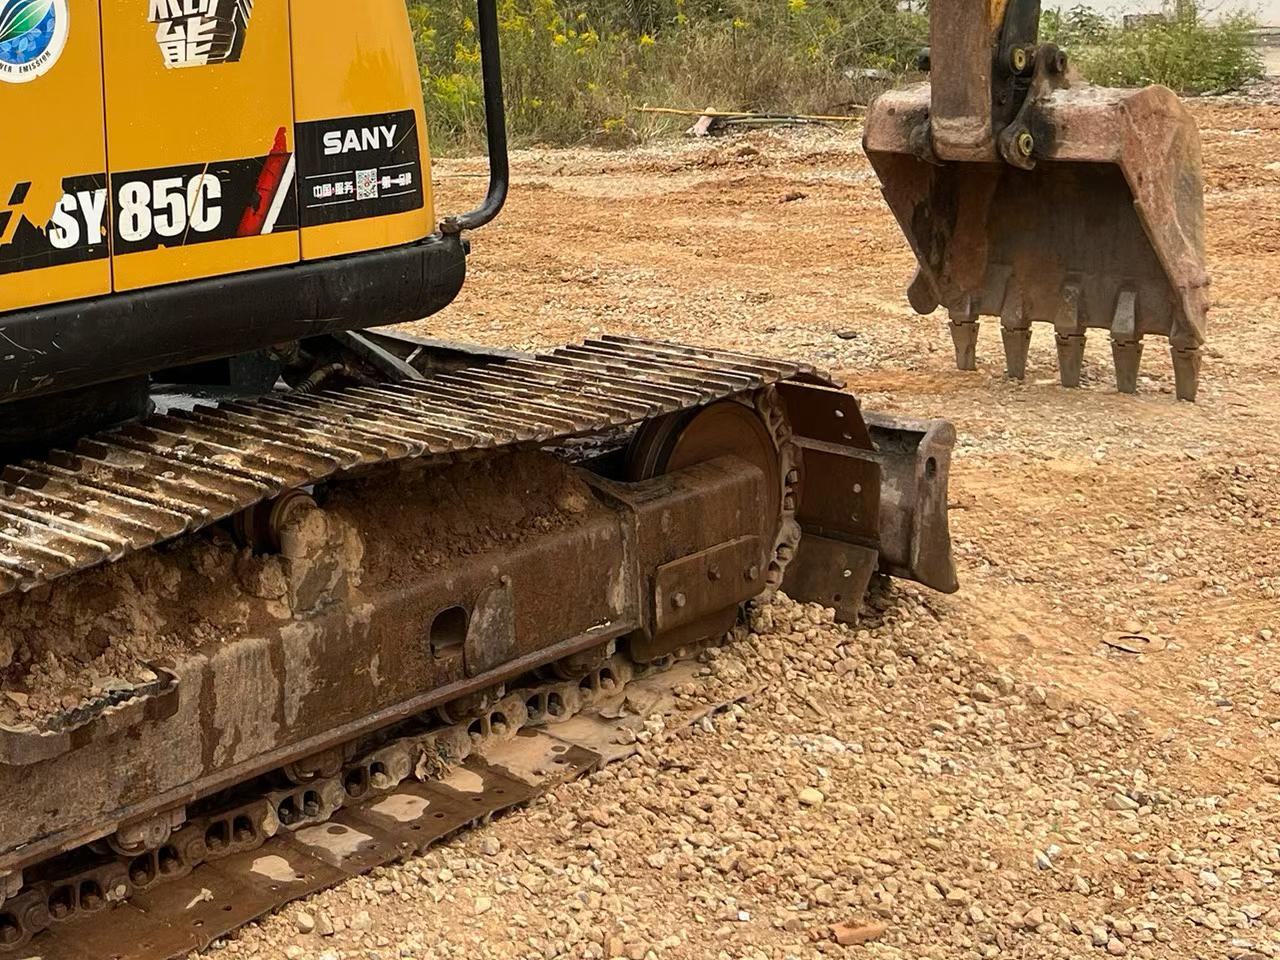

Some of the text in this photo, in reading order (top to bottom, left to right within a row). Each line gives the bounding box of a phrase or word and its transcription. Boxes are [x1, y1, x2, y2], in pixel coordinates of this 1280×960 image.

[156, 16, 218, 69] 能
[19, 50, 51, 73] EMISSION
[323, 124, 397, 155] SANY
